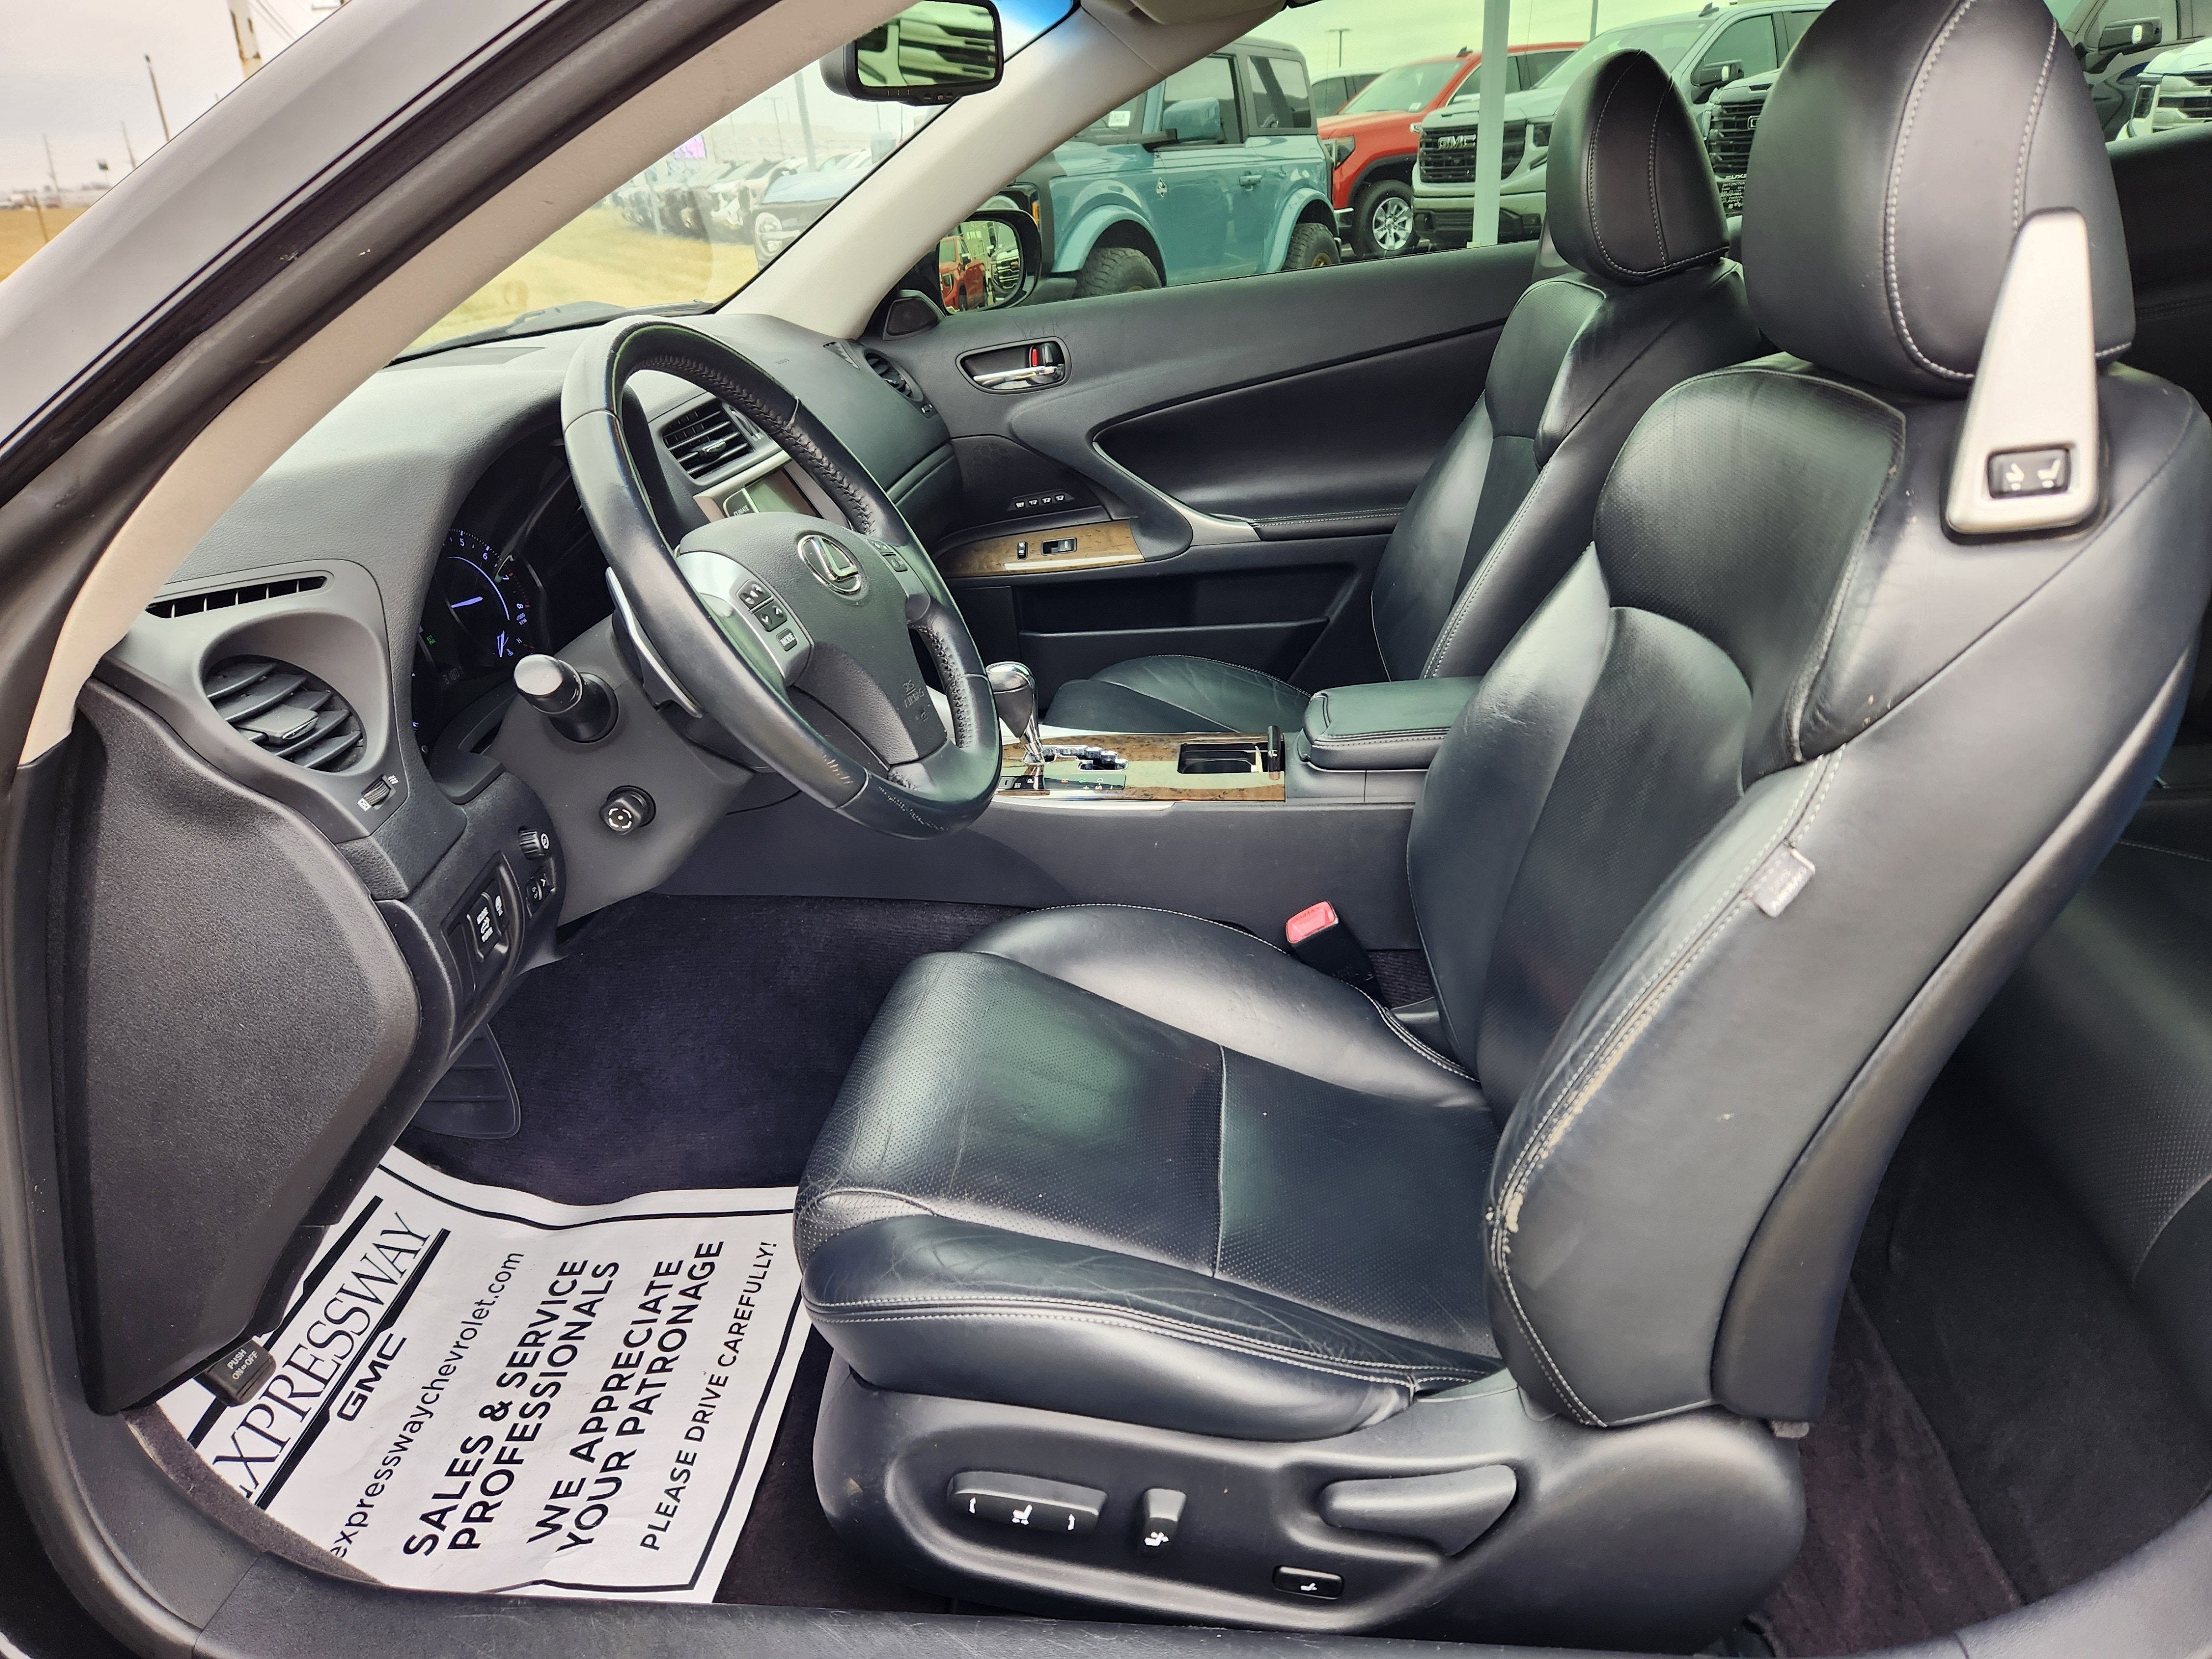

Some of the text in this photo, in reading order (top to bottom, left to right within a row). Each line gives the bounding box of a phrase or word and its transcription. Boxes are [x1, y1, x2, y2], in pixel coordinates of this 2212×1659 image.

[1438, 134, 1476, 150] GMC
[460, 538, 465, 546] 5
[733, 505, 749, 516] CLIMATE
[780, 632, 795, 646] MODE
[227, 1349, 247, 1370] PUSH
[330, 1253, 524, 1558] expresswaychevrolet.com
[337, 1333, 407, 1421] GMC
[403, 1260, 588, 1556] SALES & SERVICE
[447, 1262, 619, 1550] PROFESSIONALS
[526, 1260, 684, 1544] WE APPRECIATE
[555, 1241, 724, 1553] YOUR PATRONAGE
[639, 1240, 778, 1551] PLEASE DRIVE CAREFULLY!
